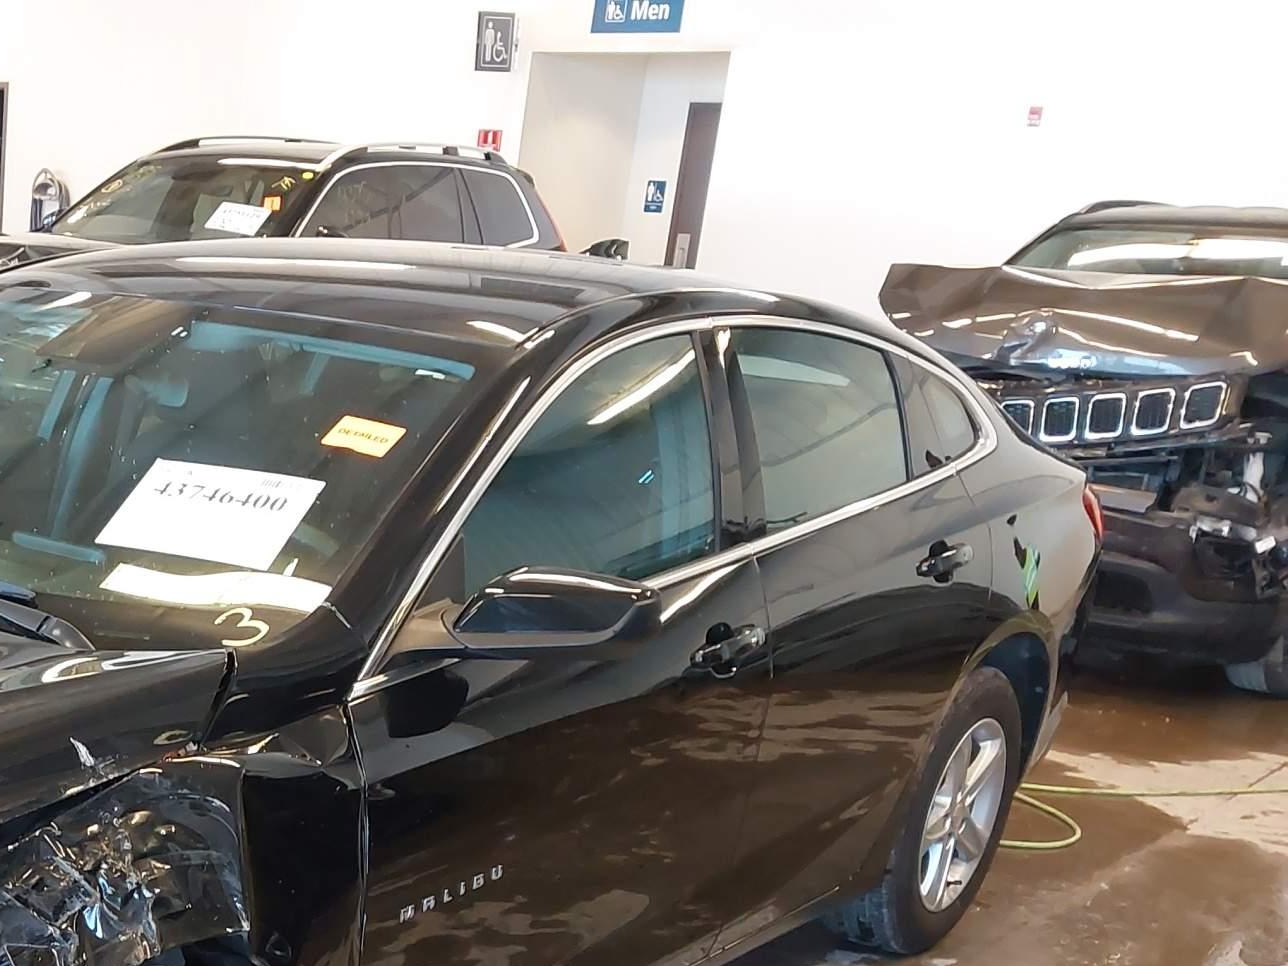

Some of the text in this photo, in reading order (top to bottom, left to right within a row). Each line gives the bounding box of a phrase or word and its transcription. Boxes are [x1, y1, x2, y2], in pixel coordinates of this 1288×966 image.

[630, 0, 671, 20] Men
[152, 480, 289, 512] 43746400
[214, 607, 270, 647] 3
[399, 864, 503, 924] MALIBU
